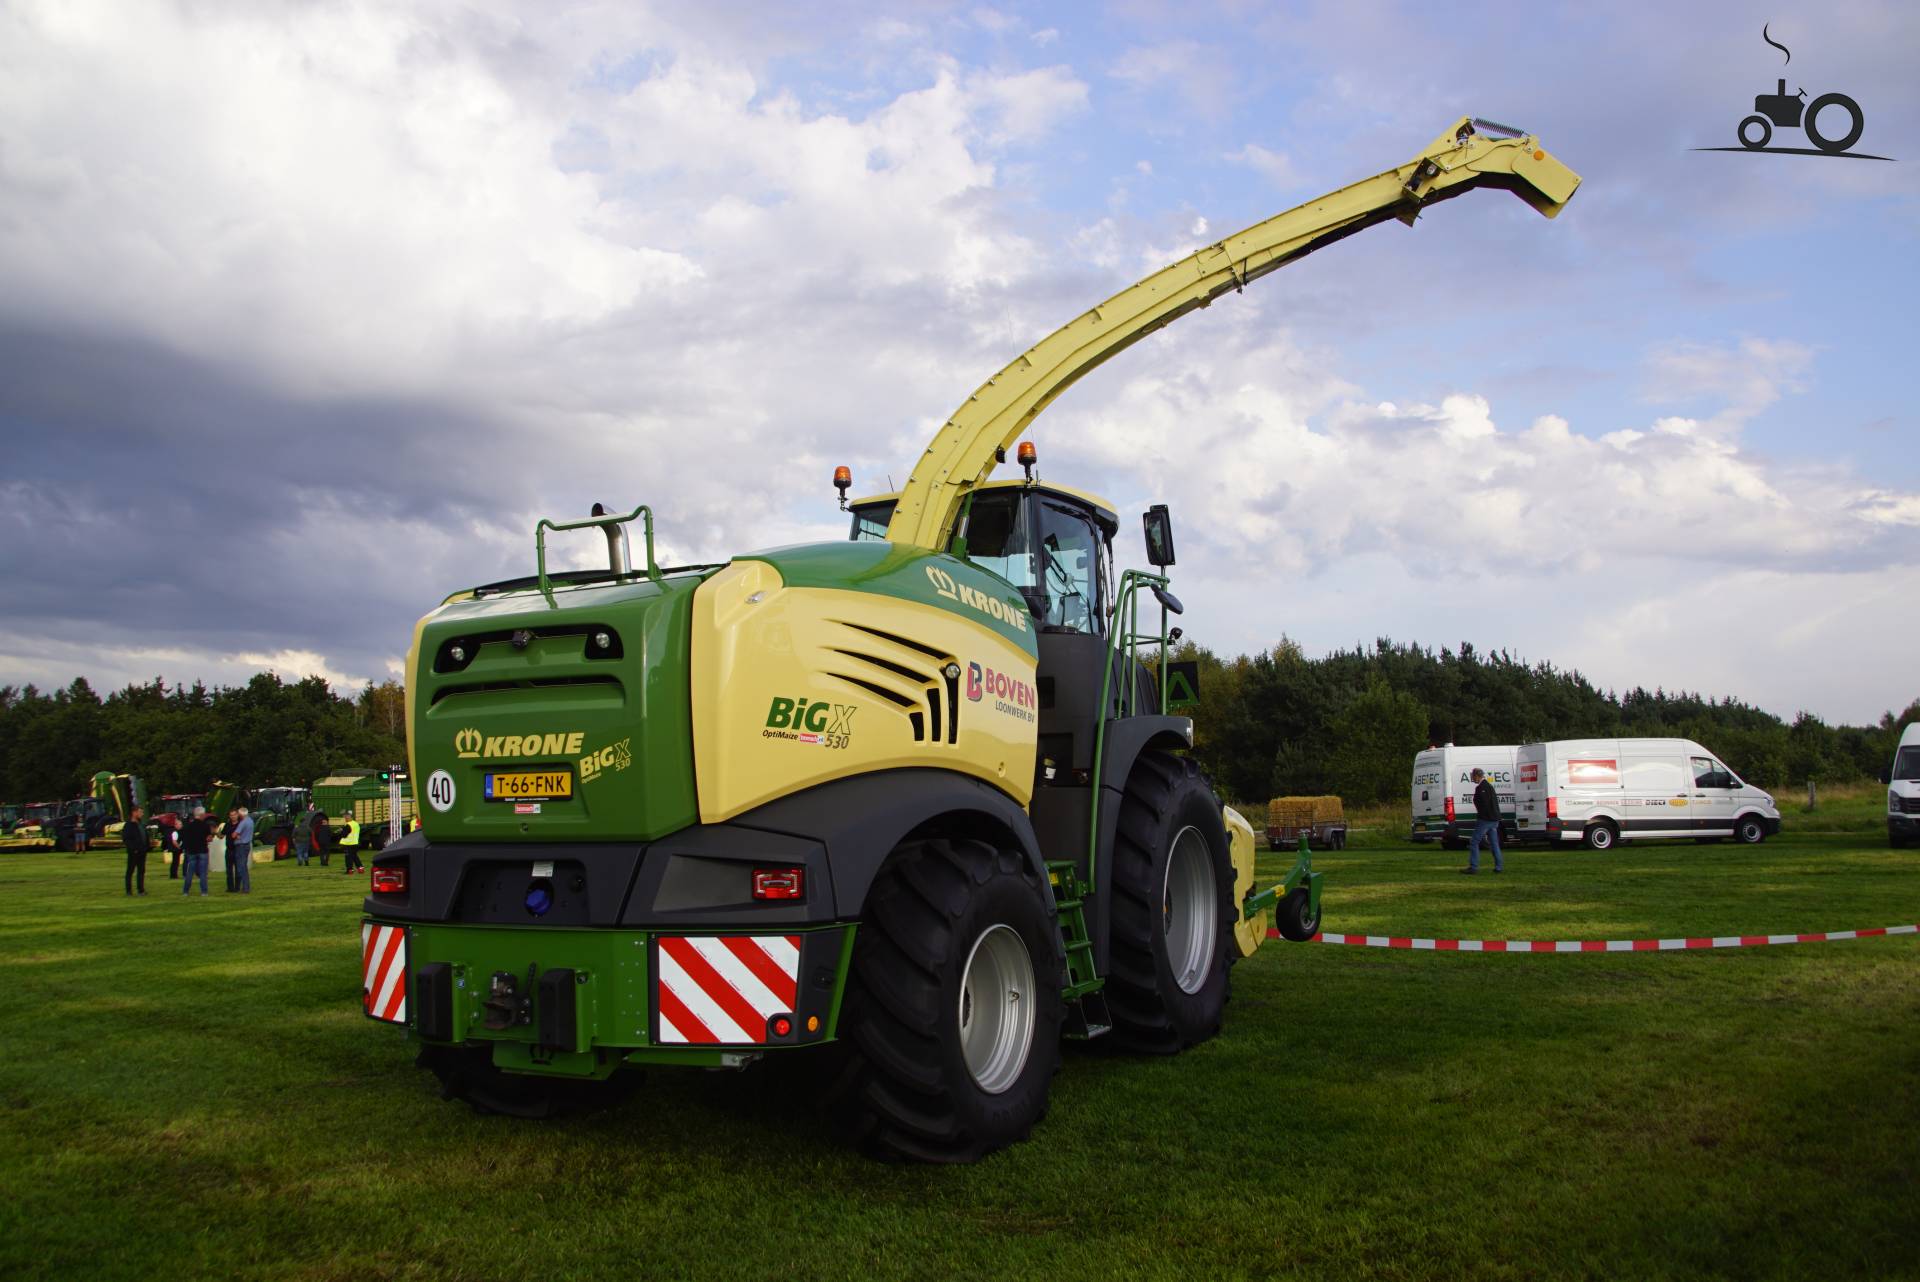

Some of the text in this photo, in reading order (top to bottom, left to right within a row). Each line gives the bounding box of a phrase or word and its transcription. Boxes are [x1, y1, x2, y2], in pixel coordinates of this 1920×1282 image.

[958, 583, 1027, 632] KRONE
[985, 667, 1035, 710] BOVEN
[483, 732, 585, 757] KRONE
[762, 729, 799, 741] OptiMaize
[824, 733, 850, 749] 530
[615, 757, 631, 772] 530
[431, 777, 451, 805] 40
[496, 774, 566, 795] T-66-FNK
